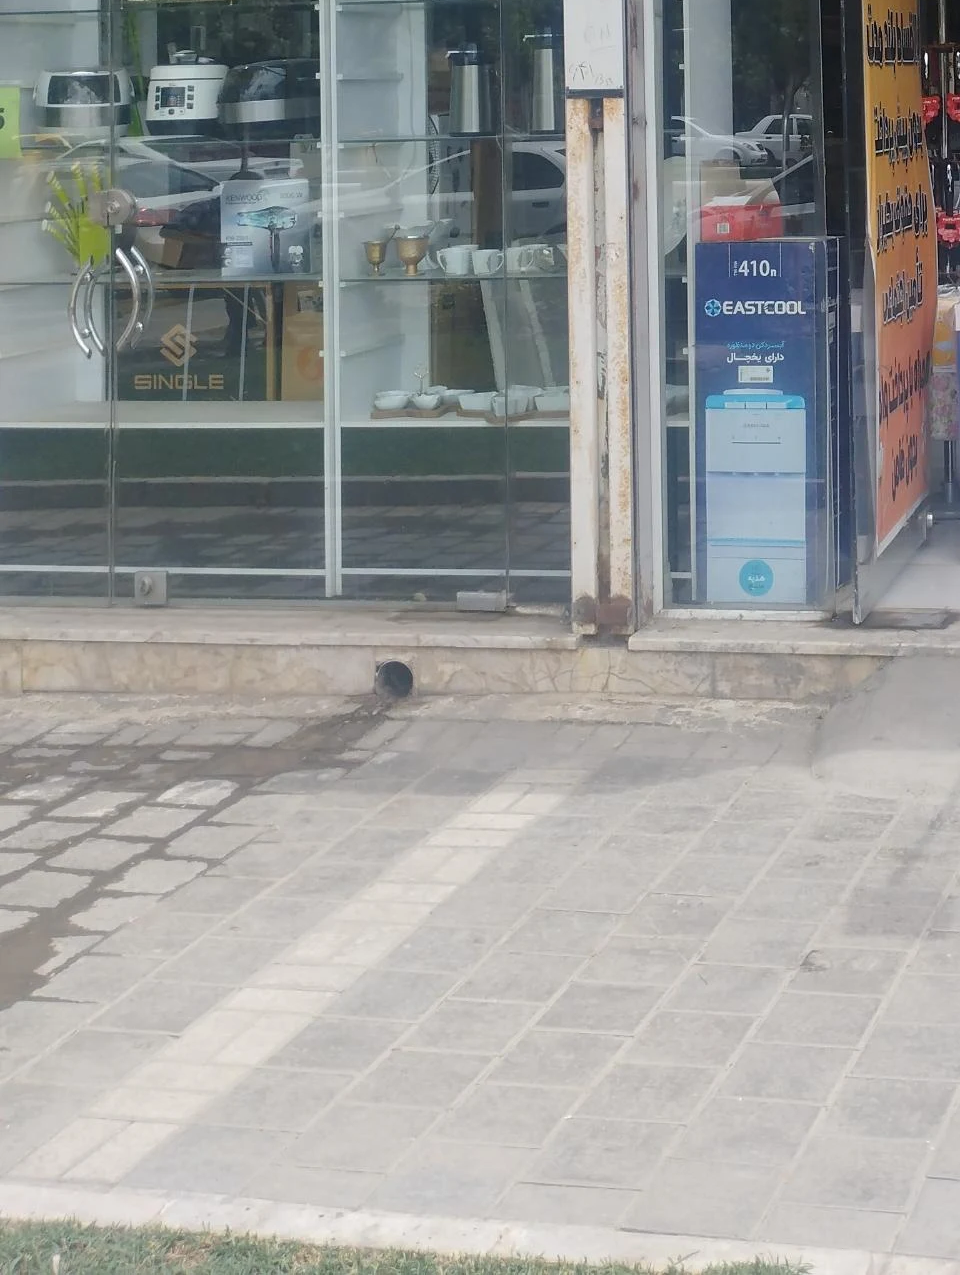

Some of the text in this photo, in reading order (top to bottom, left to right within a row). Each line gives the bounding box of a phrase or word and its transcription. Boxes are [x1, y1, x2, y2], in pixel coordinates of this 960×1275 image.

[722, 300, 807, 315] EASTCOOL
[726, 352, 785, 364] دارای یخچال
[134, 374, 225, 390] SINGLE
